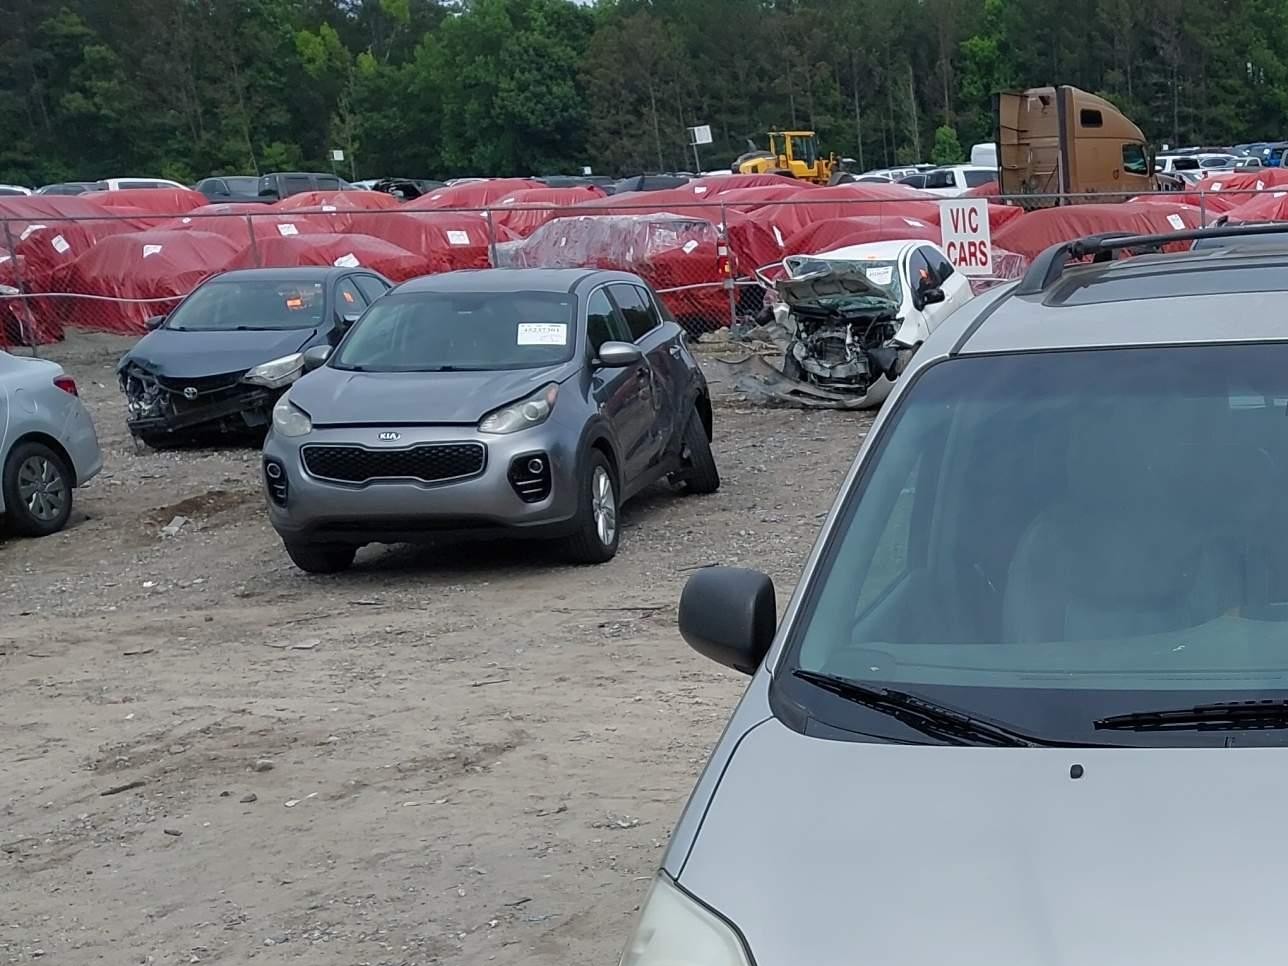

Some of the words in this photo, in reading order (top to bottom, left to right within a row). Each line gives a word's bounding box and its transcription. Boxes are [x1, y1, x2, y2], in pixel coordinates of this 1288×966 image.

[950, 207, 979, 233] VIC
[947, 241, 988, 266] CARS
[380, 432, 400, 440] KIA
